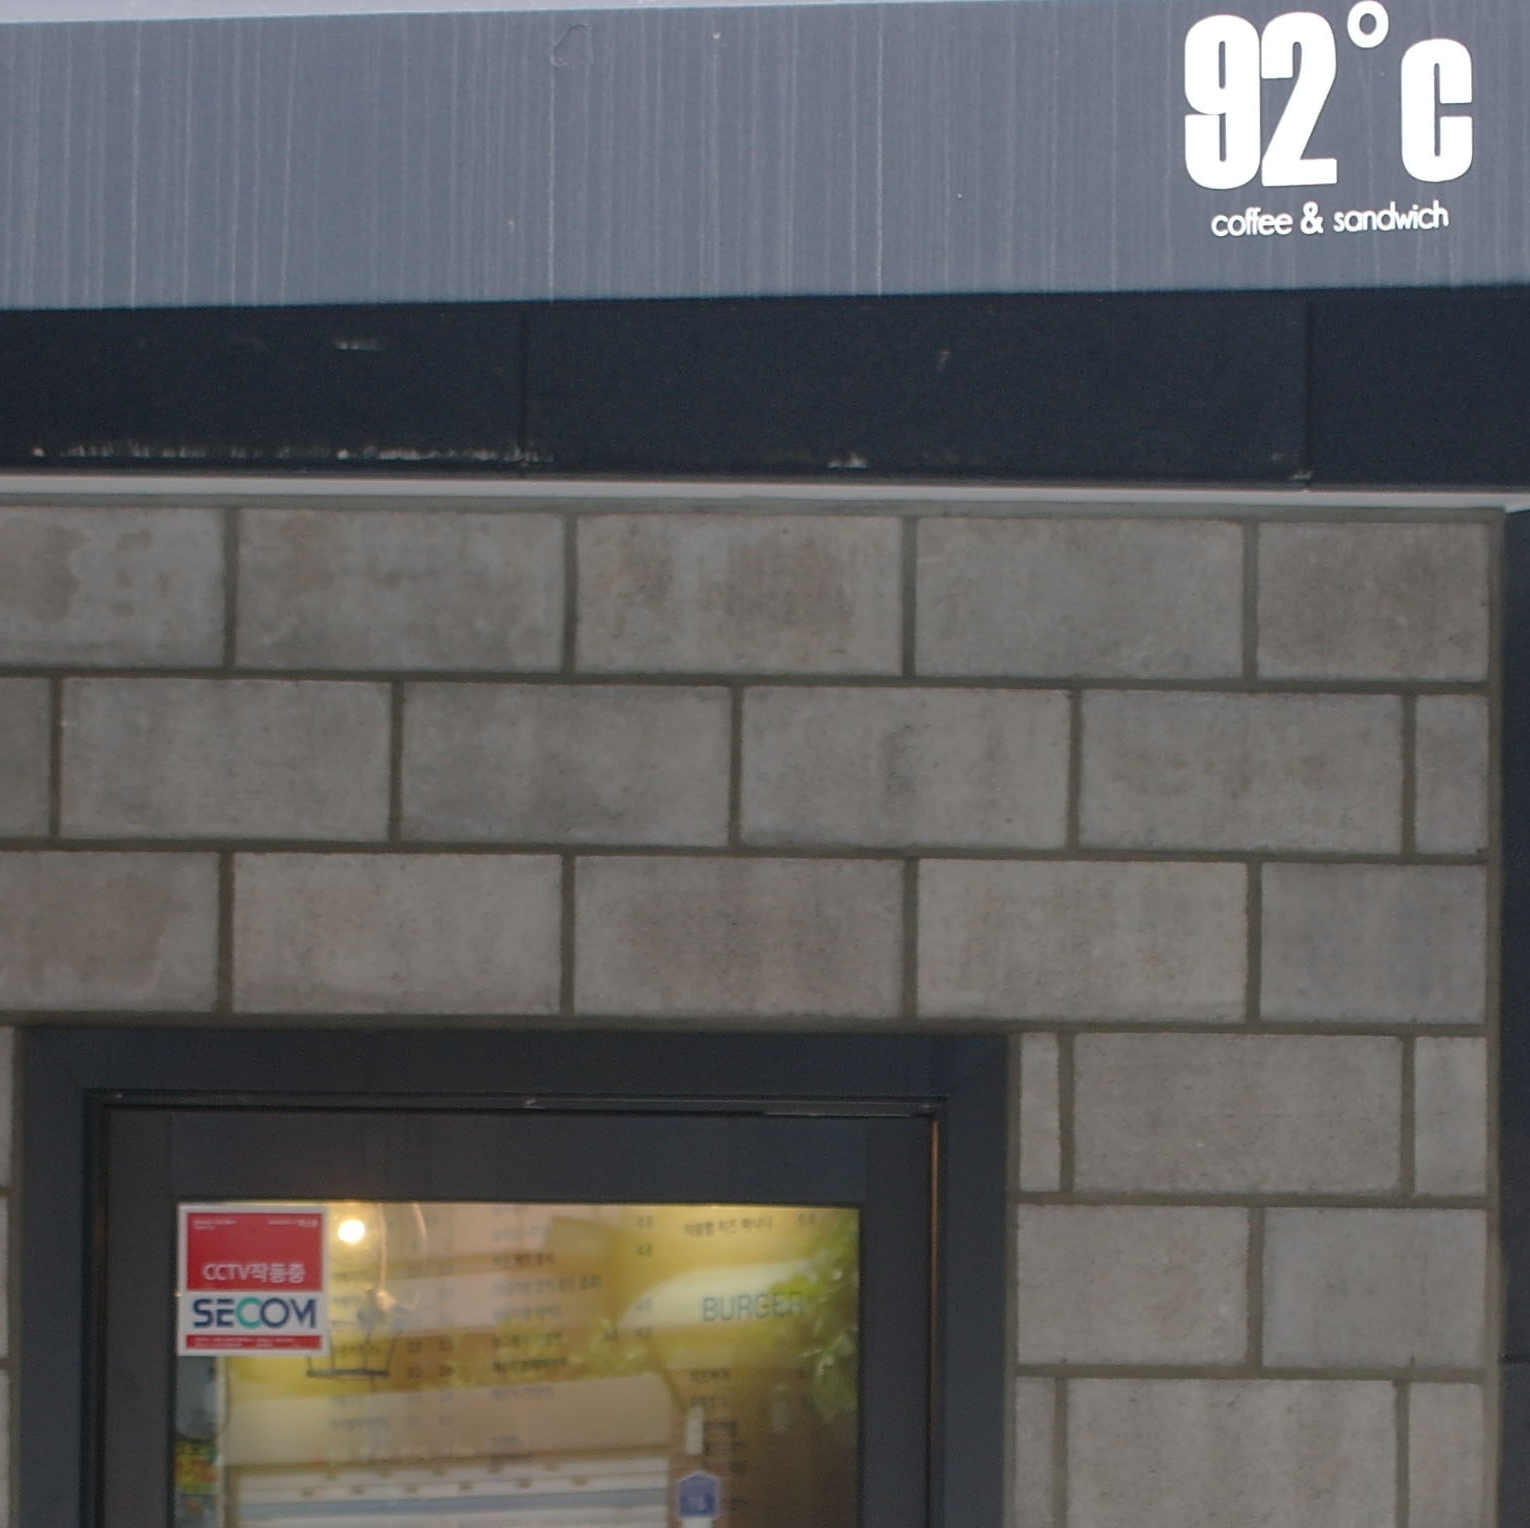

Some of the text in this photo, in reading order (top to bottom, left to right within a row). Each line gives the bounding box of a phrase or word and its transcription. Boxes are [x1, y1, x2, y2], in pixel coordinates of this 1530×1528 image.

[1211, 200, 1450, 237] coffee & sandwich
[202, 1262, 307, 1284] CCTV작동중
[193, 1297, 317, 1329] SECOM
